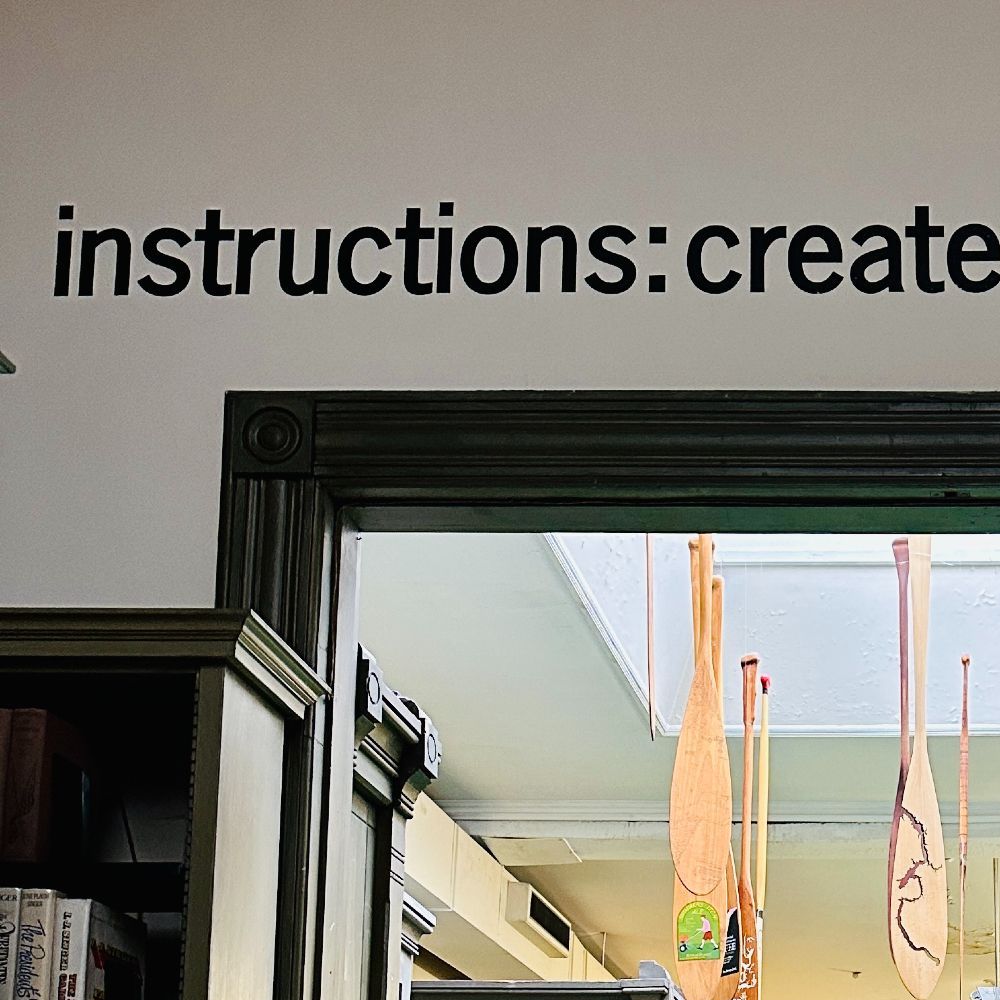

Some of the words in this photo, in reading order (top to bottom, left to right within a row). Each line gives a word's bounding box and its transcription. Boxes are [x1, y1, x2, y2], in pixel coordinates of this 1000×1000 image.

[54, 202, 666, 296] instructions:
[21, 919, 46, 944] The
[15, 943, 46, 999] President's
[68, 973, 78, 998] THE
